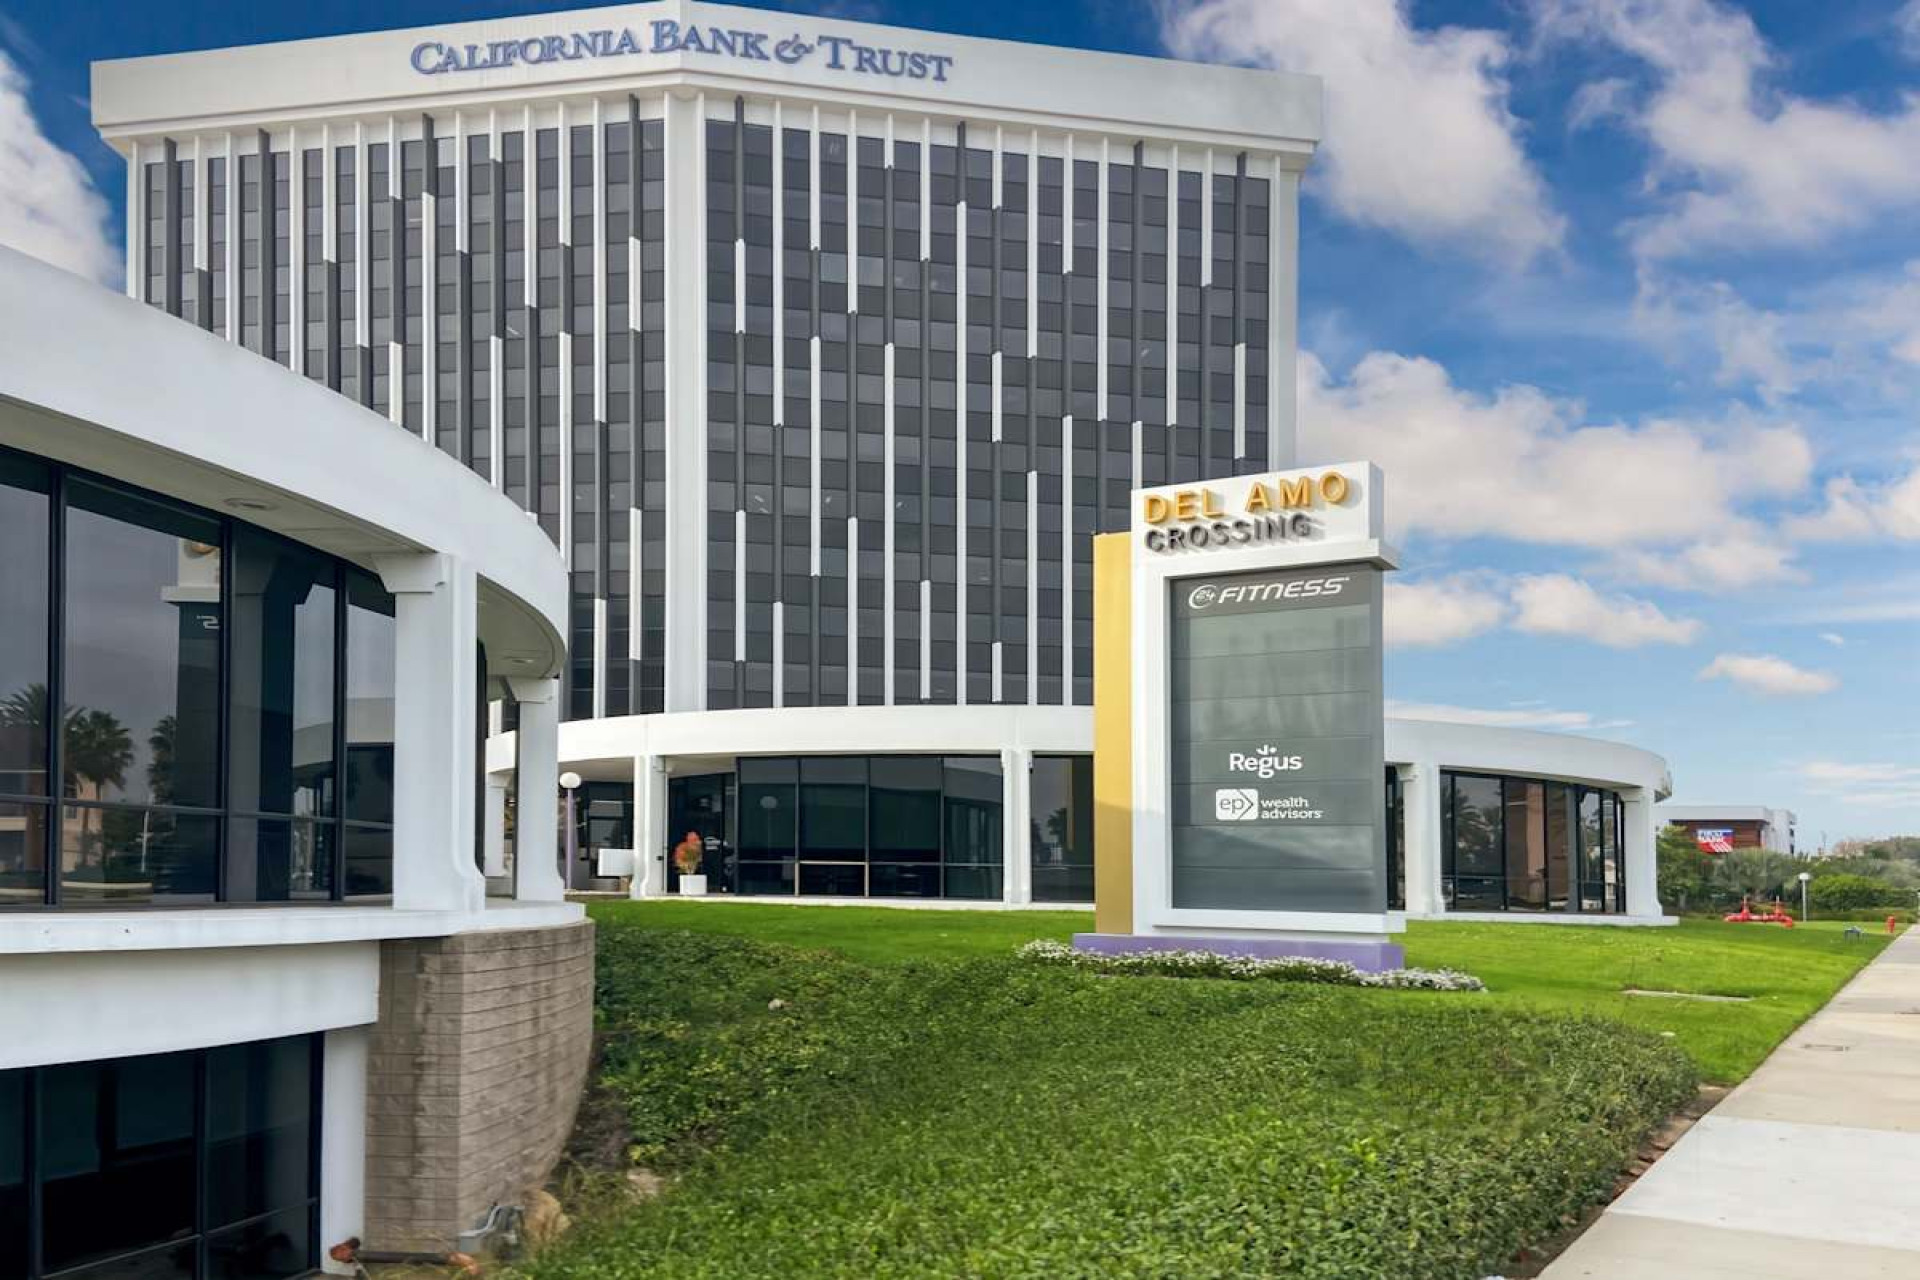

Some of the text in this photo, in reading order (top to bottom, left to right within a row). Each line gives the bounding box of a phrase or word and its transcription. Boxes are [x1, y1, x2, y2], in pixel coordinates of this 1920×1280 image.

[410, 19, 954, 83] CALIFORNIA BANK & TRUST
[1144, 471, 1348, 524] DEL AMO
[1145, 513, 1313, 552] CROSSING
[1218, 577, 1347, 604] FITNESS
[1229, 752, 1303, 779] Regus
[1260, 796, 1310, 808] wealth
[1261, 809, 1323, 819] advisors
